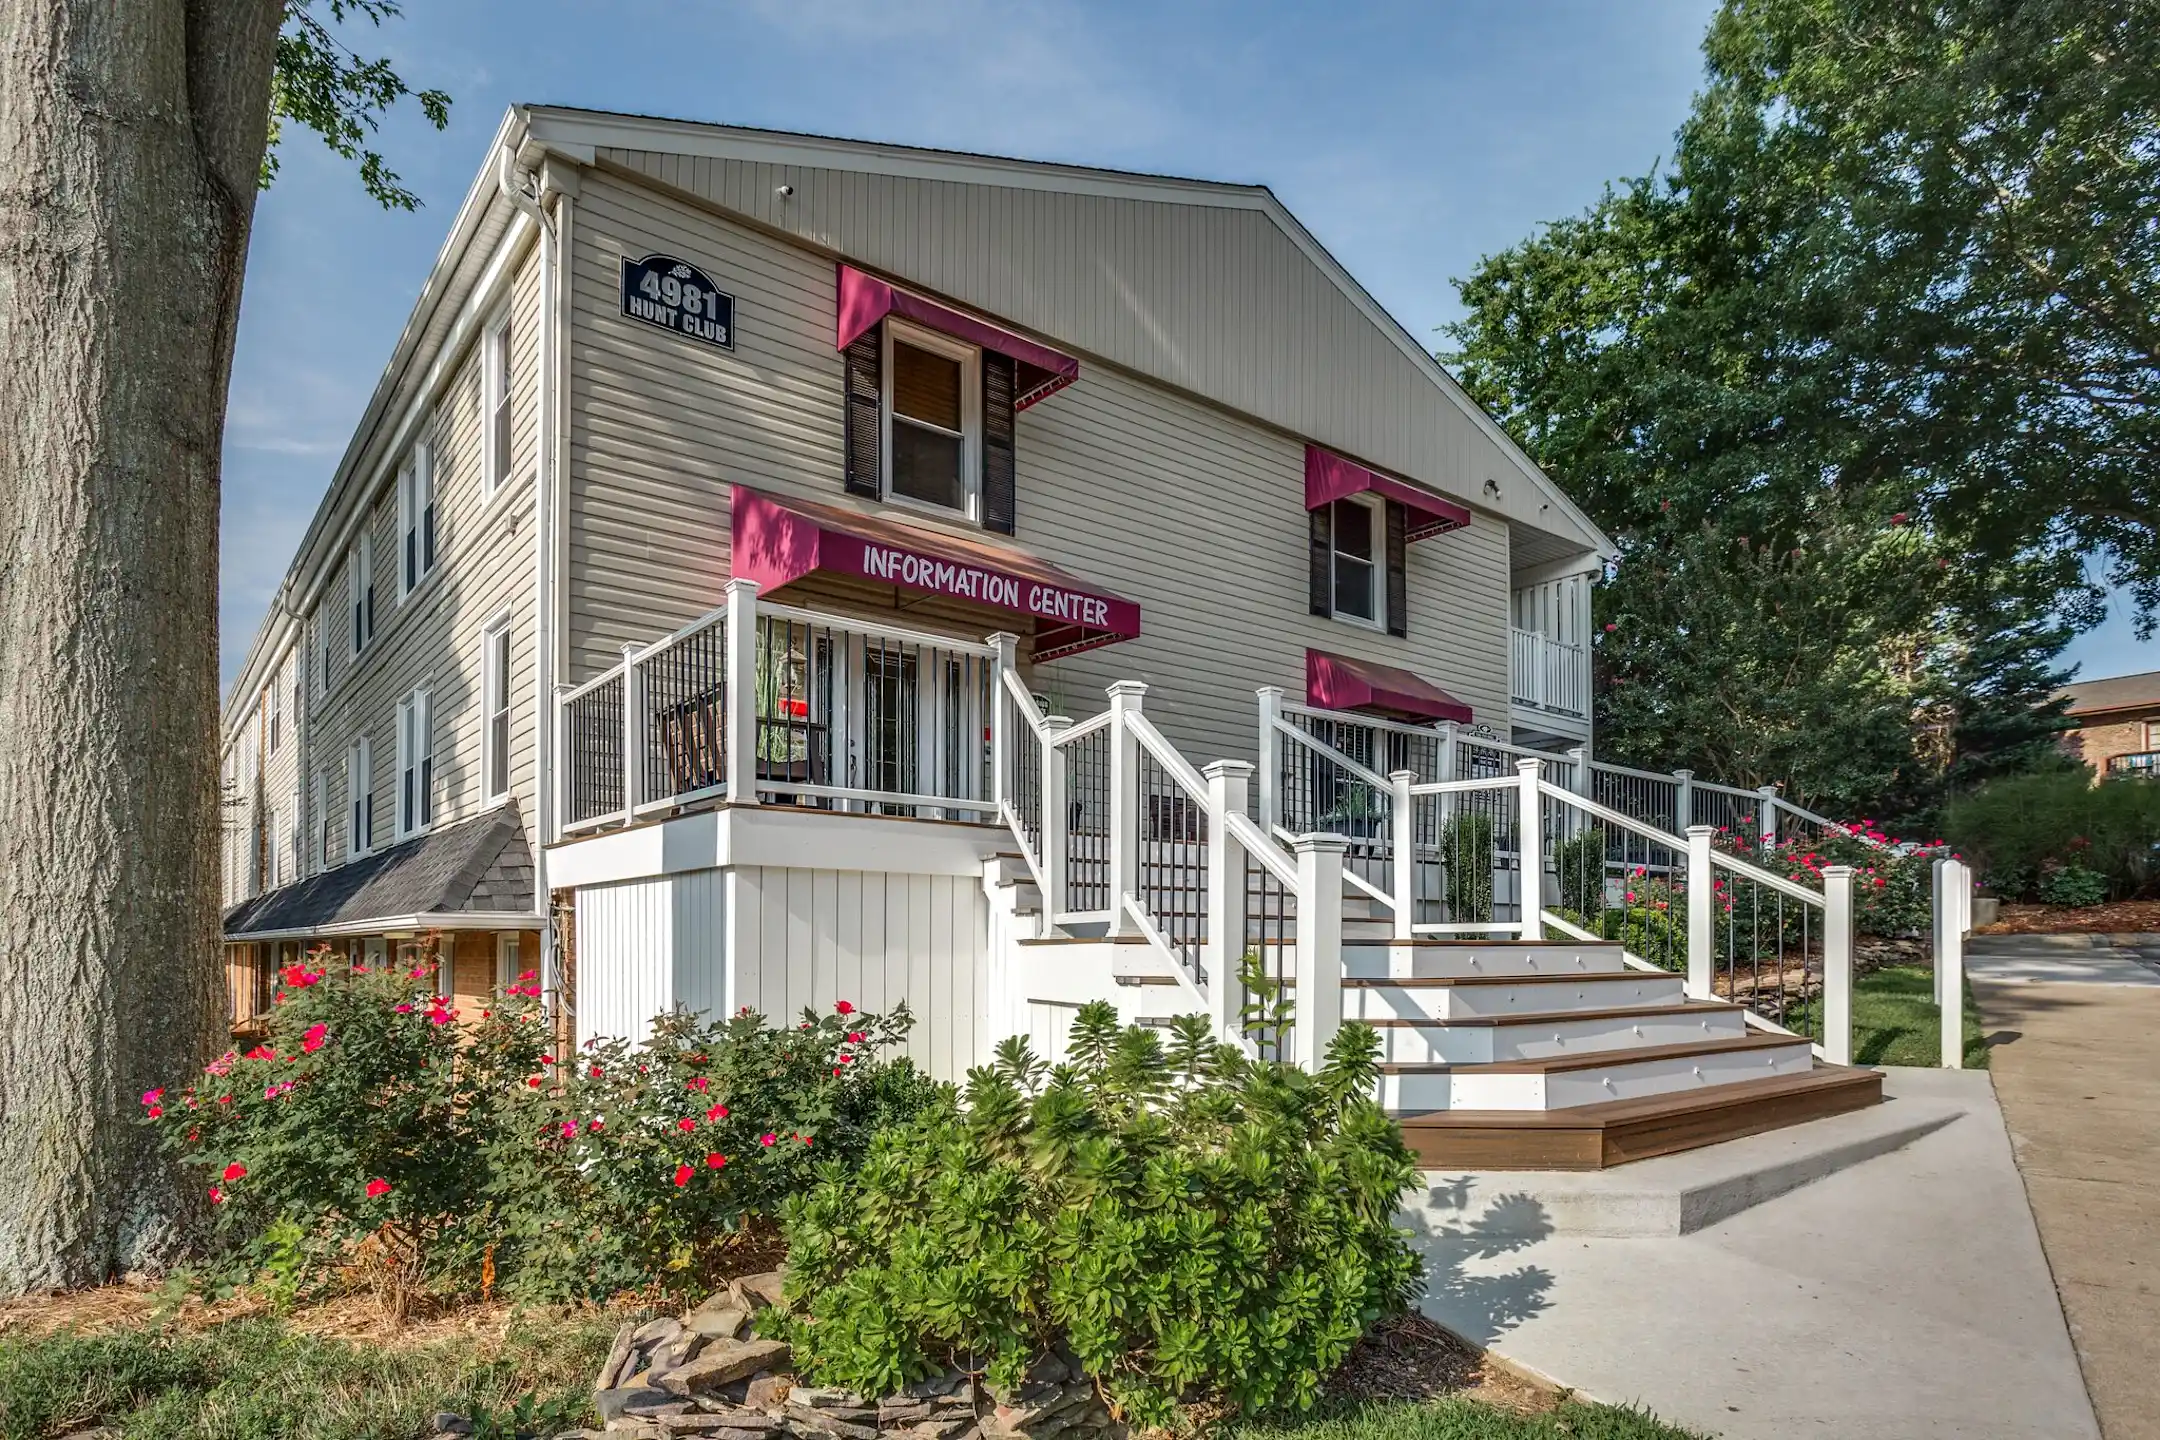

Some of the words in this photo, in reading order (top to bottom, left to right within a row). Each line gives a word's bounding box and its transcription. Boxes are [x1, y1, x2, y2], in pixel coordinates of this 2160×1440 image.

[630, 295, 677, 327] HUNT
[682, 314, 726, 343] CLUB
[640, 270, 717, 320] 4981
[863, 545, 1019, 607] INFORMATION
[1028, 585, 1108, 626] CENTER
